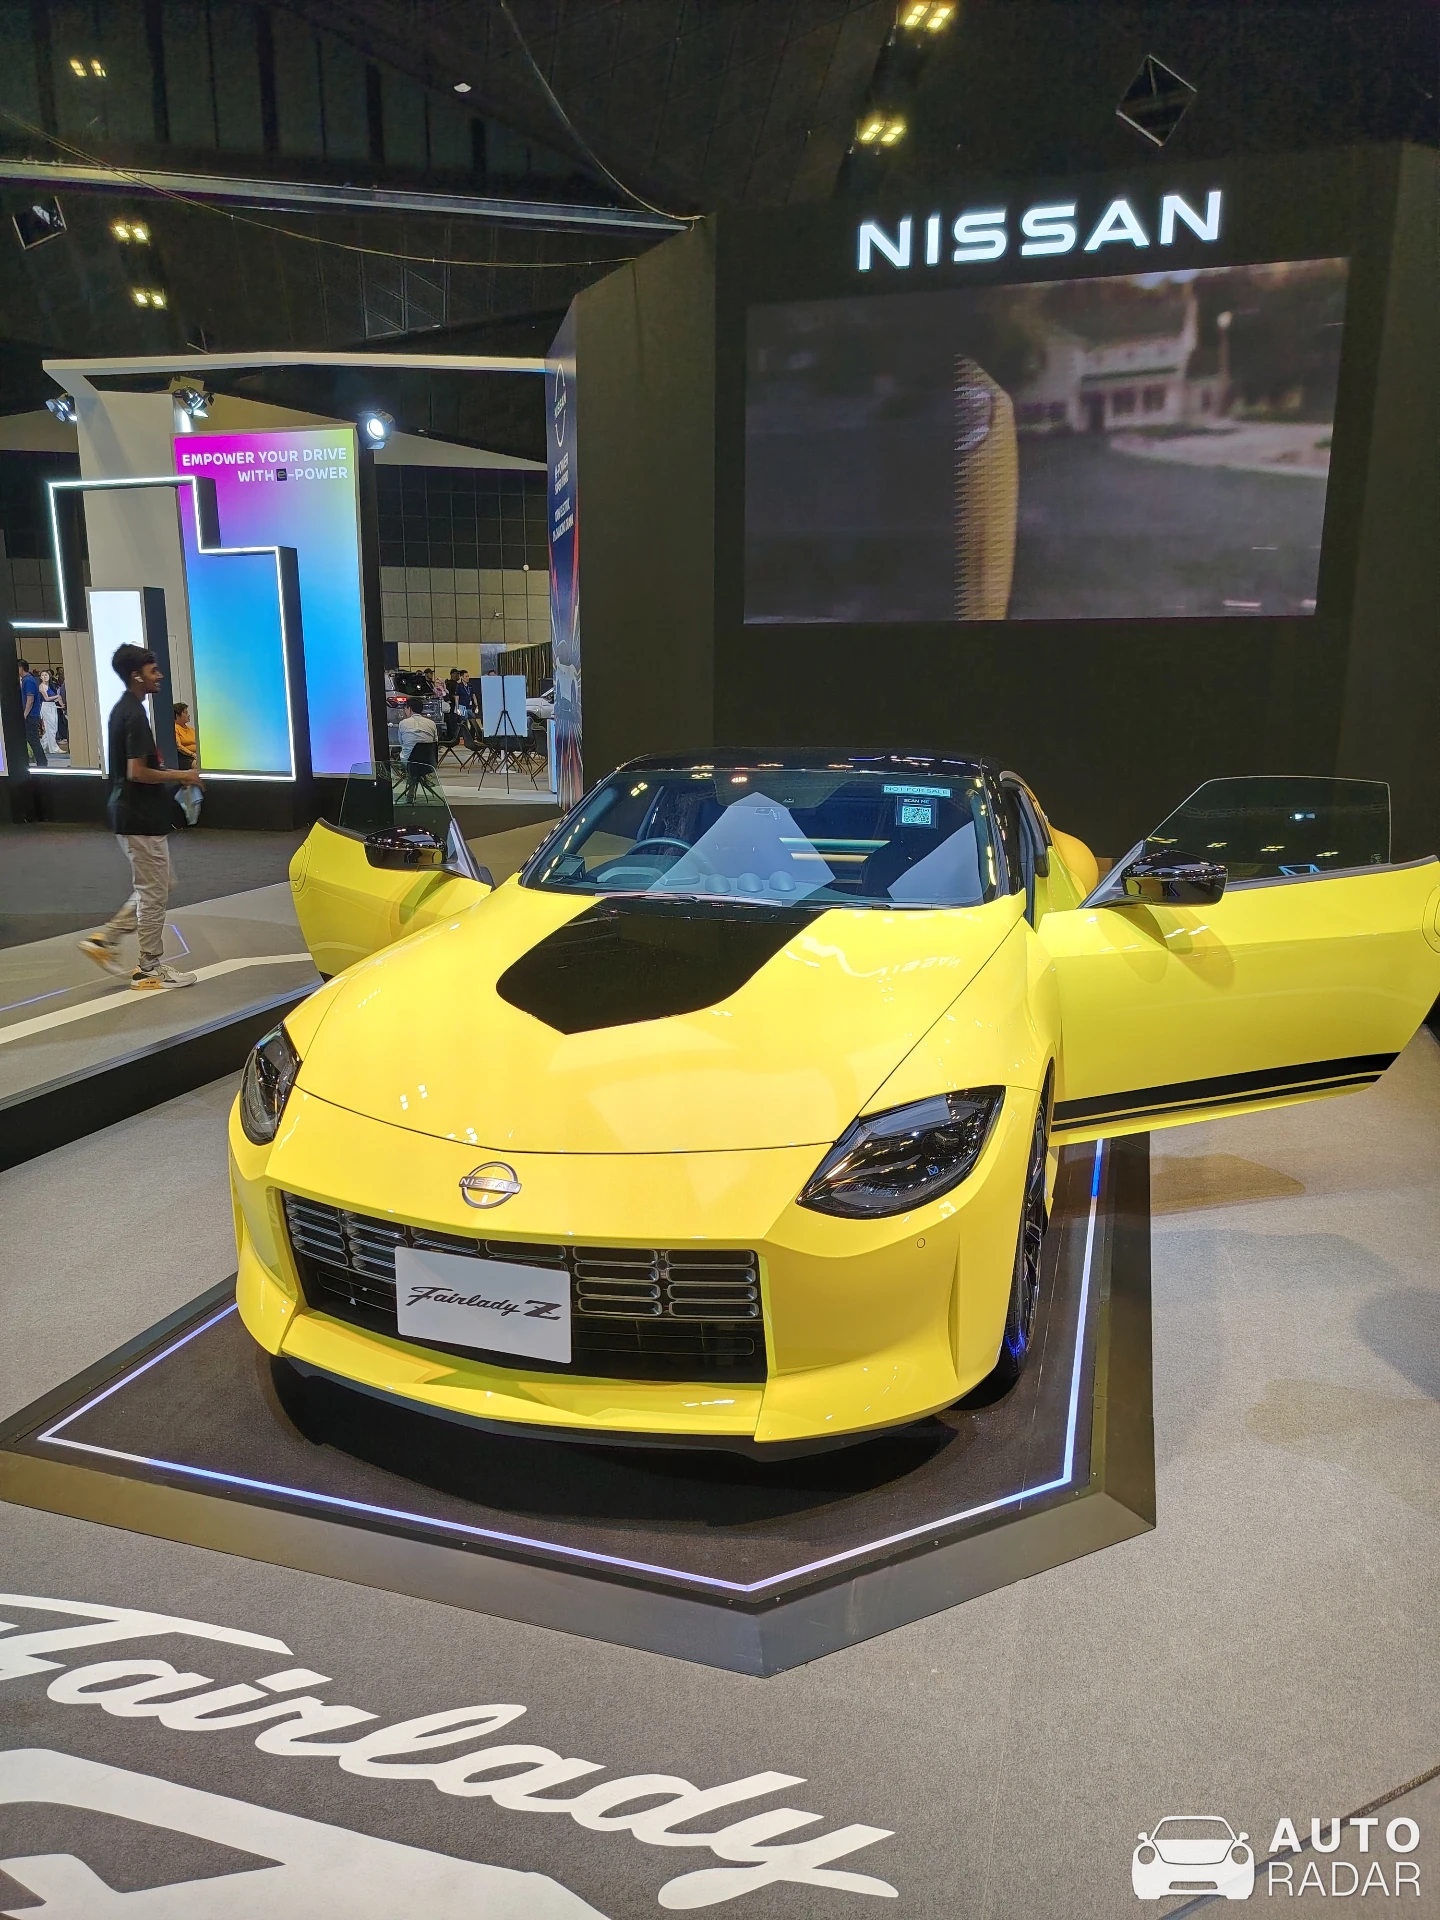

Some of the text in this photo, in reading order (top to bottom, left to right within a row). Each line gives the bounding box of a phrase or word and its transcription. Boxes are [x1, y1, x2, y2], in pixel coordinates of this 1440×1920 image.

[857, 189, 1222, 272] NISSAN
[182, 447, 347, 467] EMPOWER YOUR DRIVE
[238, 470, 275, 483] WITH
[459, 1177, 520, 1191] NISSAN
[405, 1286, 563, 1321] Fairlady Z
